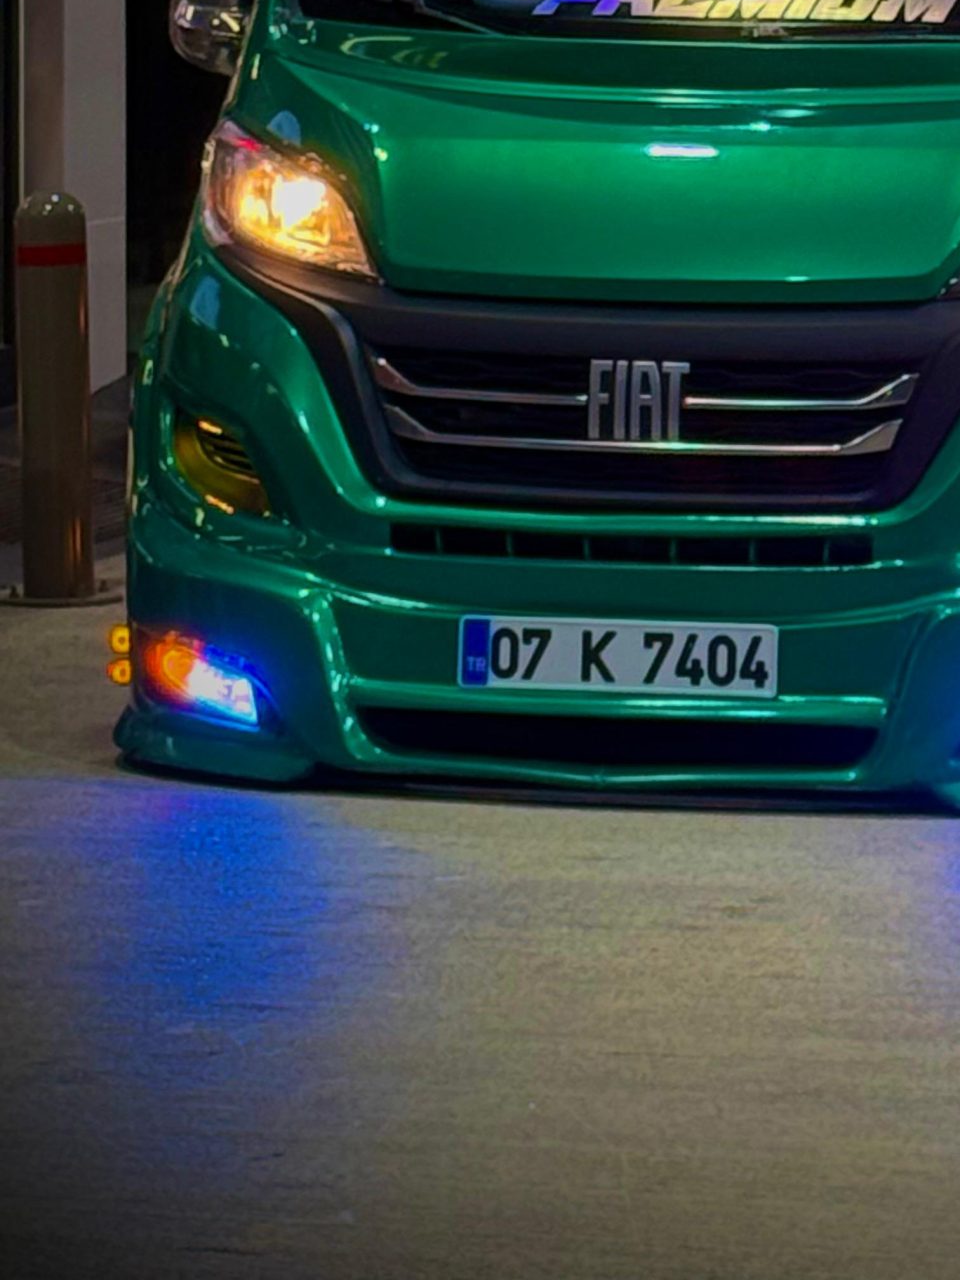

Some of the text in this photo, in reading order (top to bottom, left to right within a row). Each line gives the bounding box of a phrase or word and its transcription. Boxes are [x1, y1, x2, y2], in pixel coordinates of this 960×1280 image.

[587, 359, 691, 441] FIAT
[466, 656, 486, 672] TR
[491, 627, 769, 688] 07 K 7404
